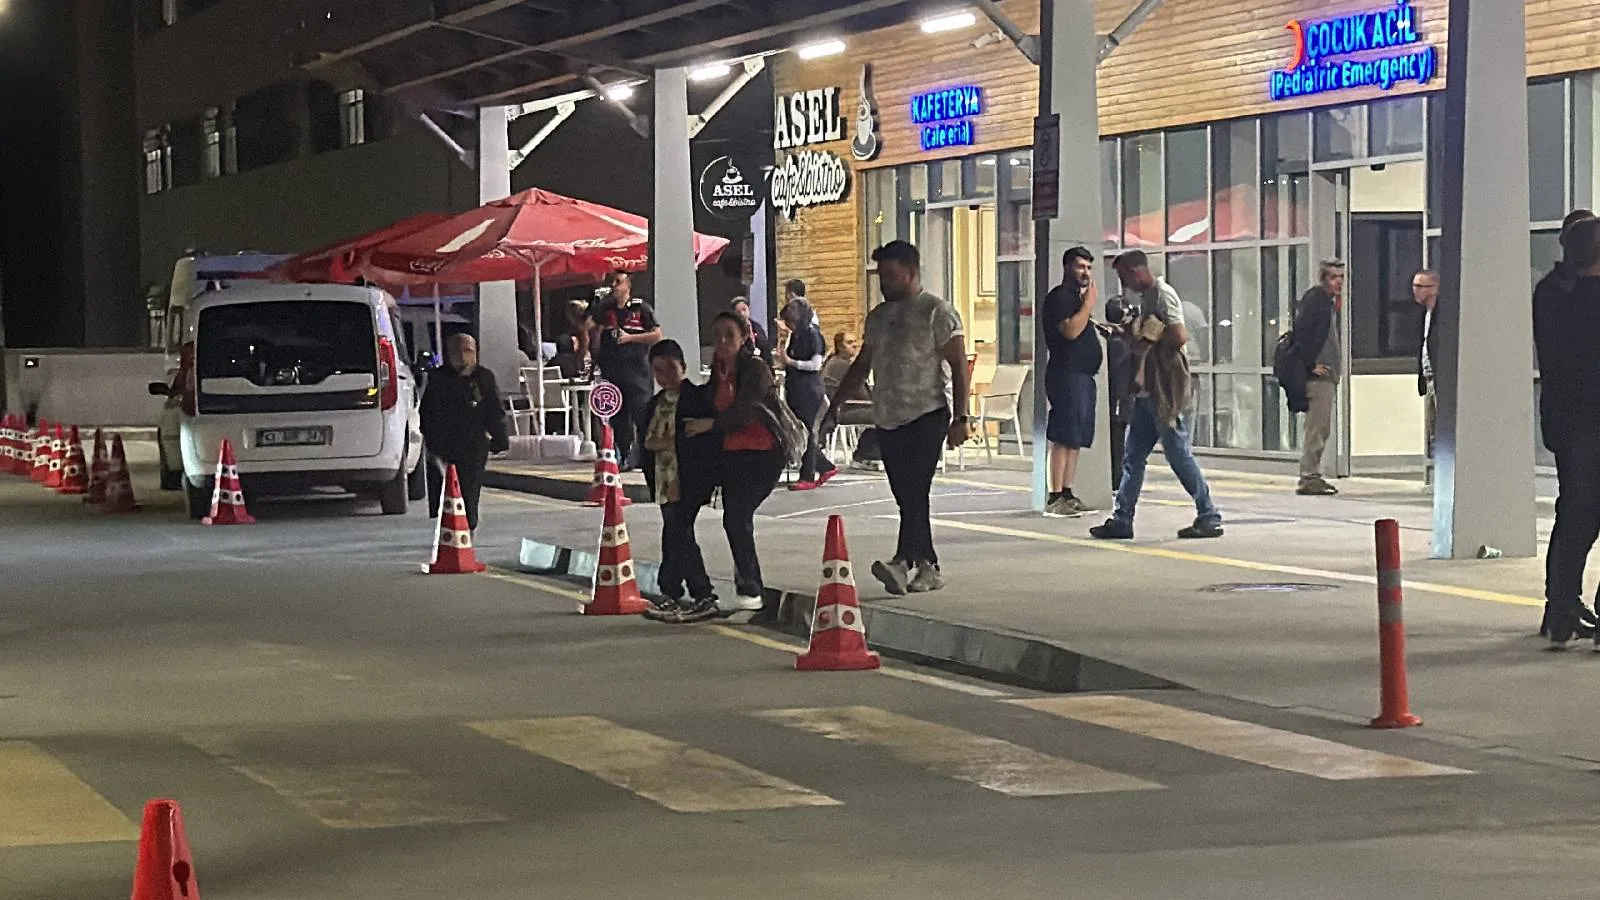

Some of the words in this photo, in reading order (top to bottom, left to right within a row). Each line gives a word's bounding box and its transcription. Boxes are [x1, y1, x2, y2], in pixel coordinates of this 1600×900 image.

[1307, 13, 1368, 58] ÇOCUK
[1371, 0, 1417, 48] ACİL
[1341, 47, 1434, 89] Emergency)
[774, 87, 841, 149] ASEL
[911, 86, 979, 121] KAFETERYA
[921, 120, 970, 149] (Cafeeria)
[712, 184, 754, 197] ASEL
